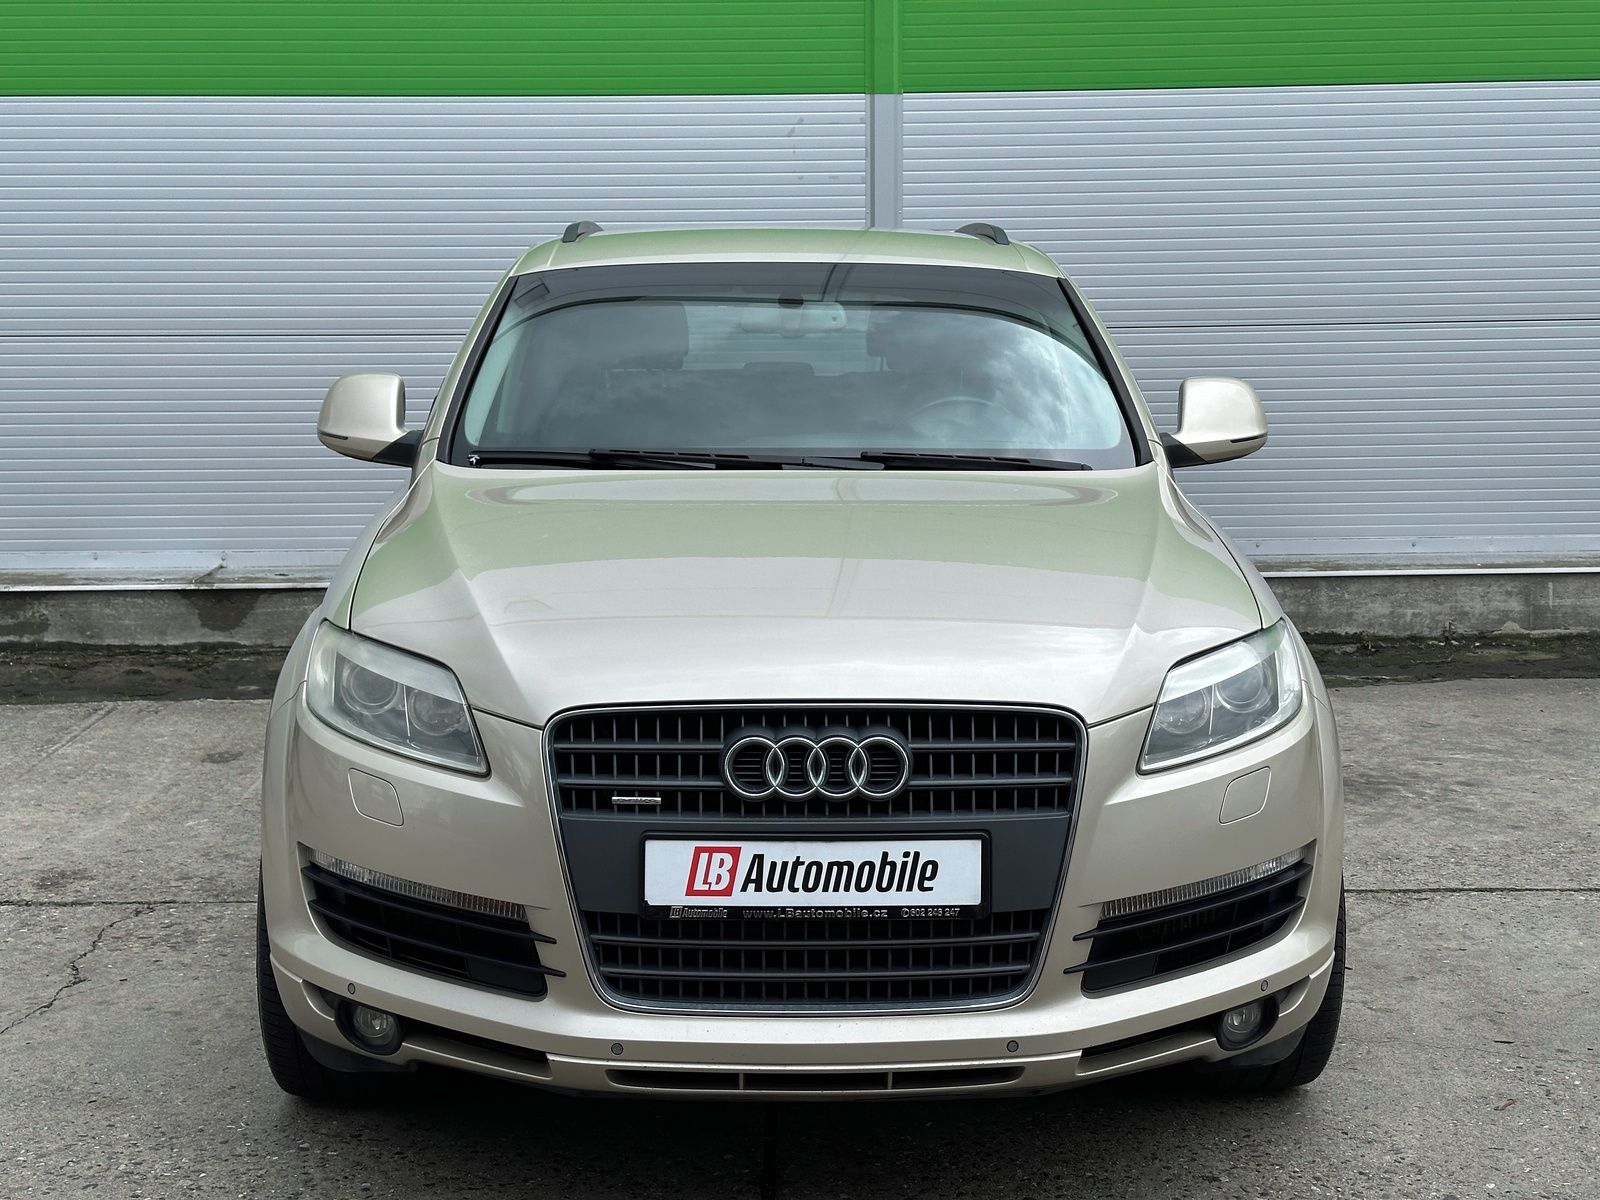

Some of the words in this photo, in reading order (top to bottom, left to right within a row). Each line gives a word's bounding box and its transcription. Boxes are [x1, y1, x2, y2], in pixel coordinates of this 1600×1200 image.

[694, 852, 733, 891] LB
[740, 851, 939, 893] Automobile
[743, 908, 888, 919] www.LBautomobile.cz
